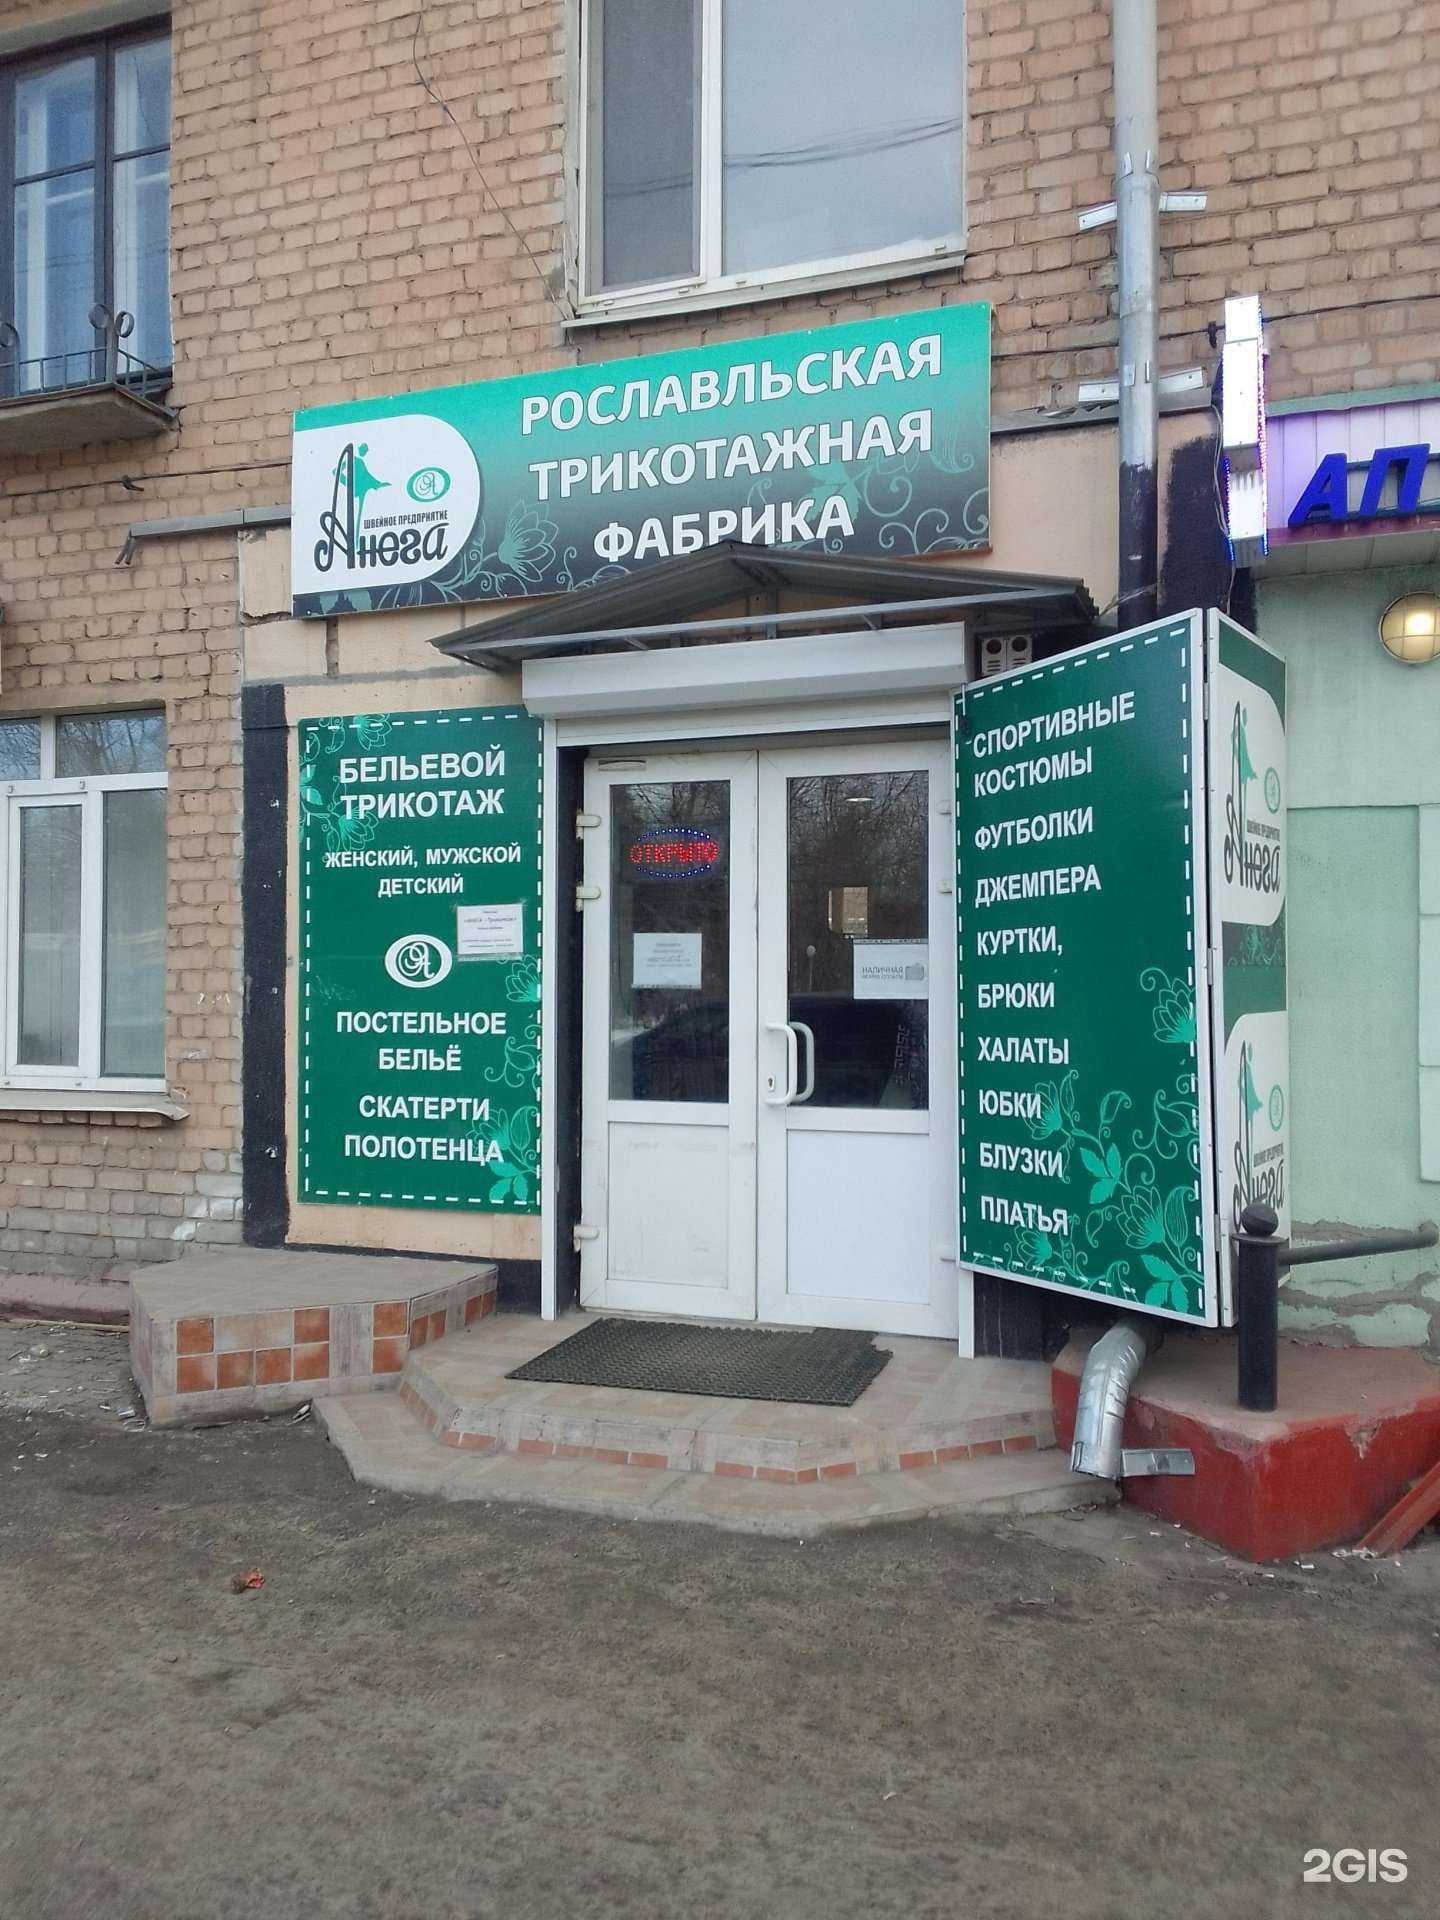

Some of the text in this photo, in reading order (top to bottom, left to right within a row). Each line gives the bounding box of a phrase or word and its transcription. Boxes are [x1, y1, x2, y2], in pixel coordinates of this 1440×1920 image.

[521, 333, 943, 436] РОСЛАВЛЬСКАЯ
[528, 408, 933, 501] ТРИКОТАЖНАЯ
[1287, 442, 1431, 527] АП
[314, 442, 450, 572] Анега
[363, 515, 397, 530] ШВЕЙНОЕ
[592, 494, 855, 563] ФАБРИКА
[972, 690, 1136, 759] СПОРТИВНЫЕ
[339, 744, 506, 784] БЕЛЬЕВОЙ
[973, 747, 1094, 799] КОСТЮМЫ
[340, 788, 505, 820] ТРИКОТАЖ
[974, 806, 1094, 852] ФУТБОЛКИ
[324, 842, 521, 868] ЖЕНСКИЙ, МУЖСКОЙ
[378, 872, 464, 898] ДЕТСКИЙ
[975, 864, 1101, 909] ДЖЕМПЕРА
[977, 925, 1063, 958] КУРТКИ,
[977, 981, 1055, 1009] БРЮКИ
[337, 1012, 506, 1035] ПОСТЕЛЬНОЕ
[378, 1044, 462, 1071] БЕЛЬЁ
[977, 1036, 1069, 1066] ХАЛАТЫ
[359, 1095, 490, 1121] СКАТЕРТИ
[978, 1089, 1042, 1119] ЮБКИ
[344, 1134, 504, 1166] ПОЛОТЕНЦА
[979, 1142, 1063, 1179] БЛУЗКИ
[980, 1196, 1069, 1236] ПЛАТЬЯ
